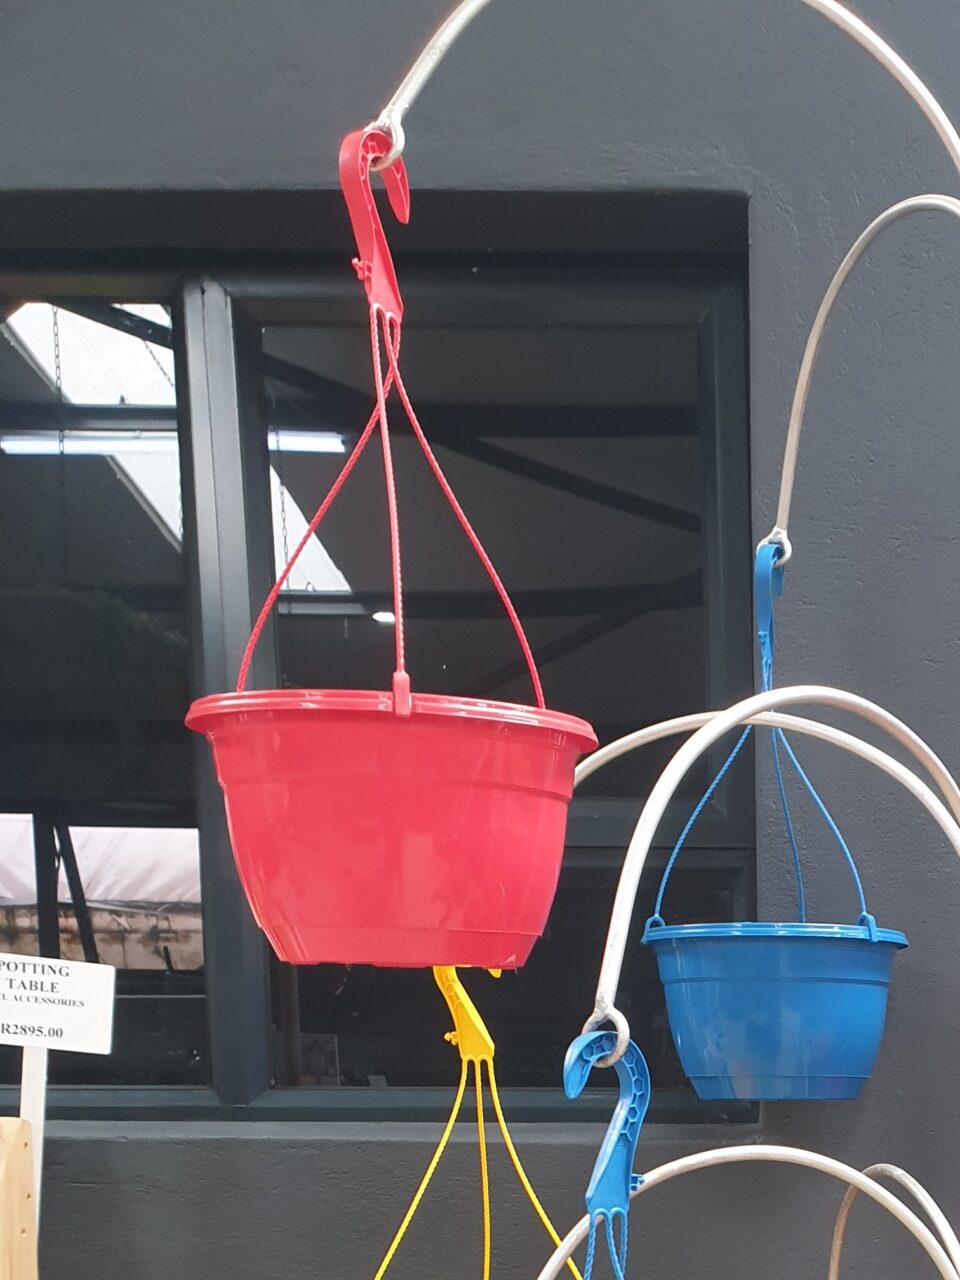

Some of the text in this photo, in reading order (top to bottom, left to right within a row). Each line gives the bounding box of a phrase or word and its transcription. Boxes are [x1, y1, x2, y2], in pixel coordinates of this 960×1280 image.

[0, 960, 70, 977] POTTING
[6, 978, 60, 993] TABLE
[11, 994, 86, 1007] ACCESSORIES
[1, 1023, 63, 1038] R2895.00
